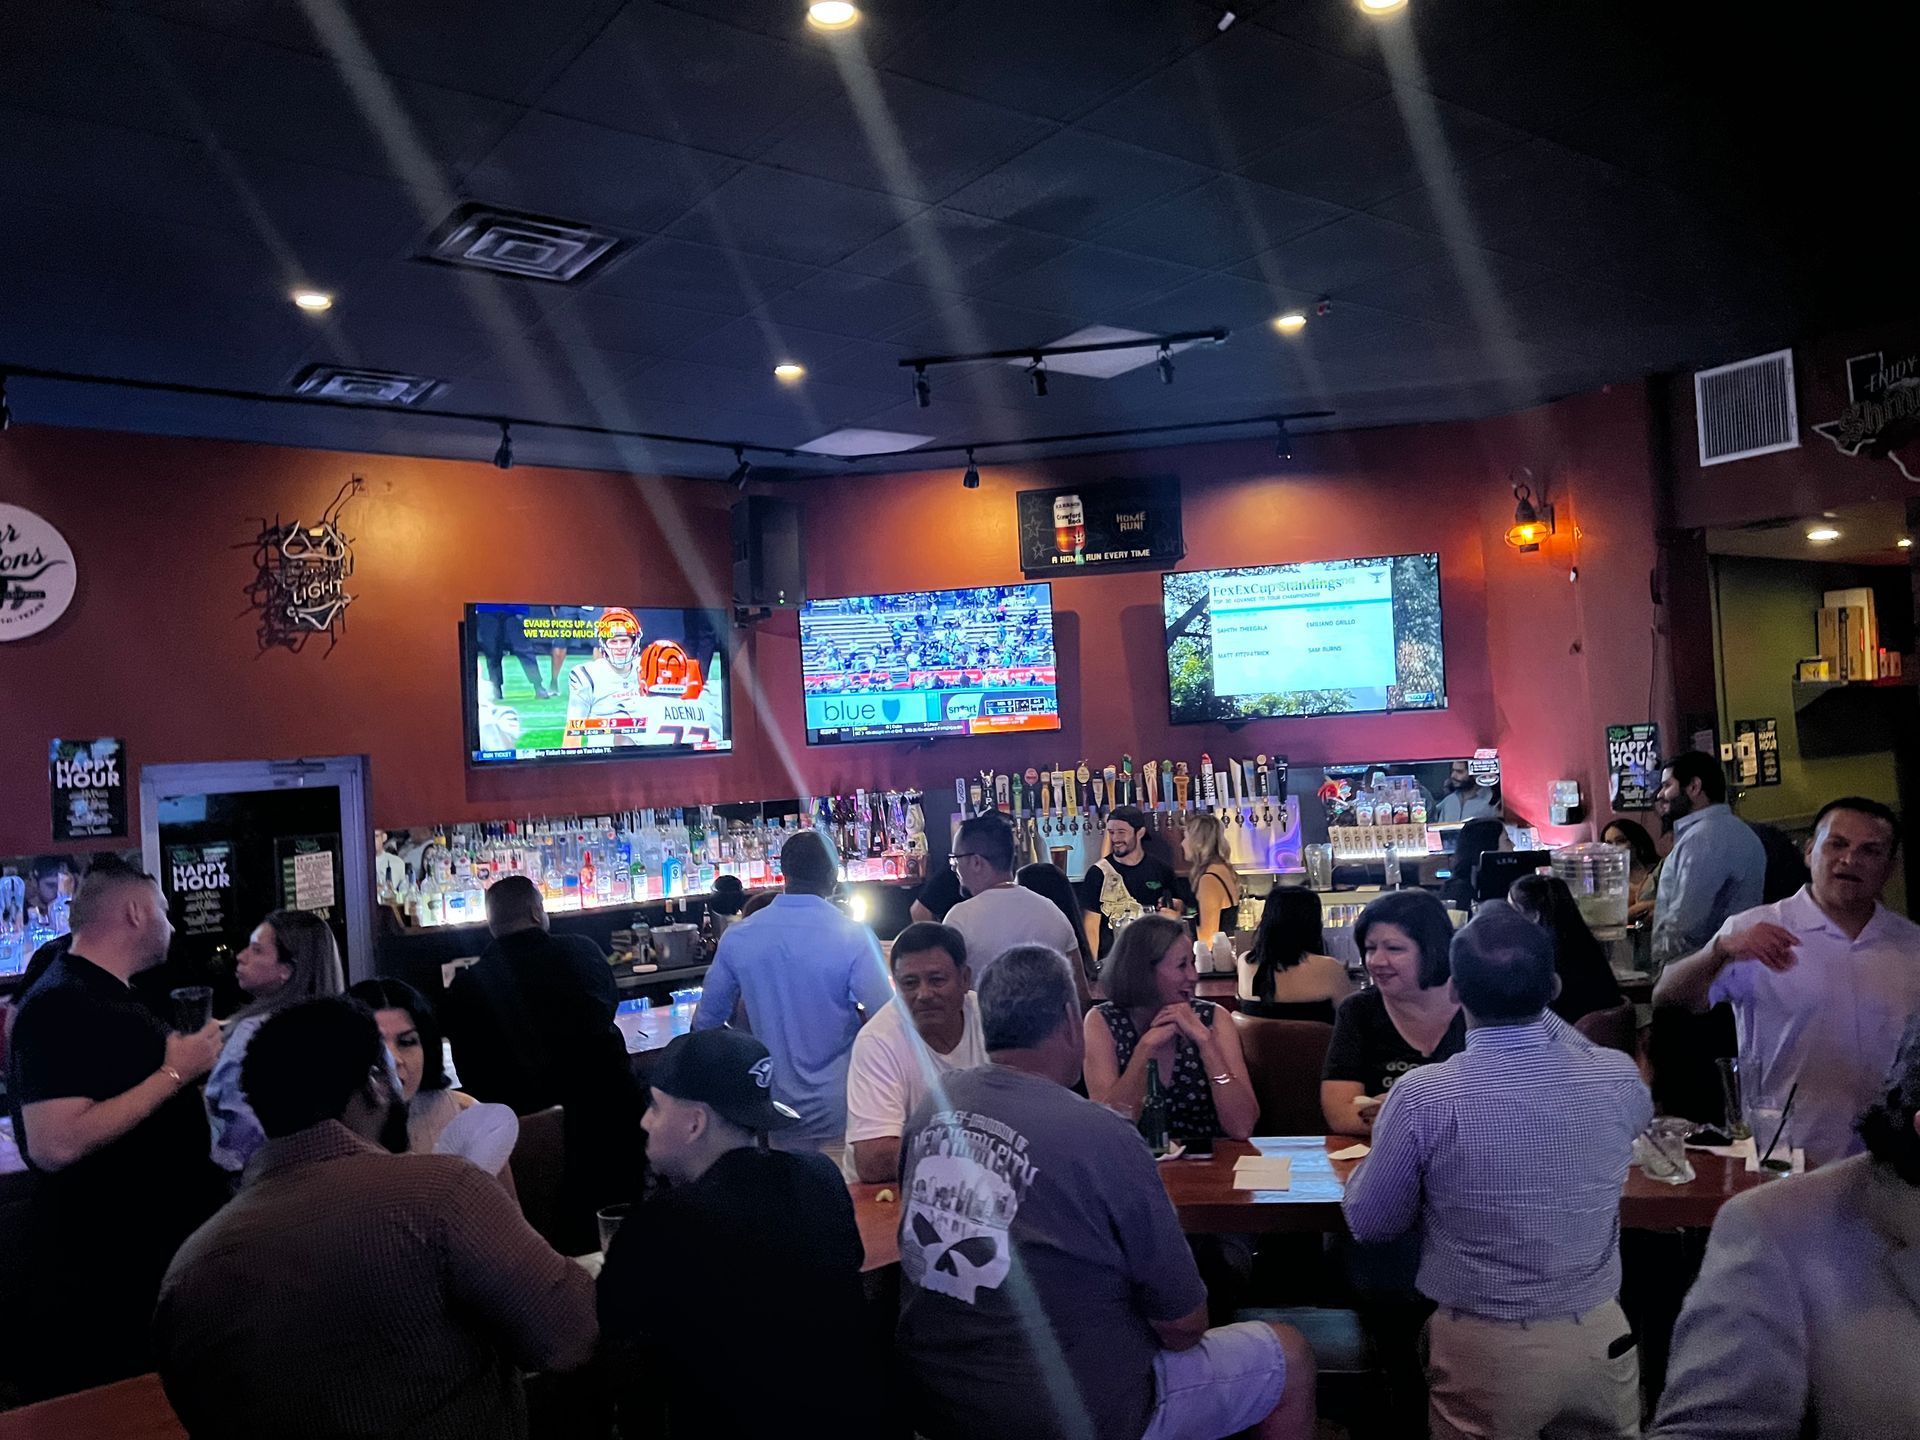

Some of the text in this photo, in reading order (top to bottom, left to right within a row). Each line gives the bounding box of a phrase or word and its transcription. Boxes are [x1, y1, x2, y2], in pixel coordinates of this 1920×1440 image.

[1116, 511, 1147, 524] HOME
[1120, 521, 1144, 533] RUN!
[1051, 549, 1151, 564] A HOME RUN EVERY TIME
[293, 577, 344, 605] LIGHT
[1277, 577, 1342, 592] Standings
[523, 619, 550, 628] EVANS
[551, 619, 574, 629] PICKS
[574, 619, 585, 629] UP
[586, 619, 593, 629] A
[1335, 618, 1356, 626] GRILLO
[524, 629, 538, 639] WE
[539, 629, 560, 639] TALK
[560, 629, 572, 639] SO
[573, 629, 597, 639] MUCH
[1322, 645, 1342, 653] BURNS
[664, 706, 705, 722] ADENIJI
[824, 700, 876, 721] blue
[948, 704, 977, 714] smart
[584, 747, 603, 755] YouTube
[1610, 740, 1654, 754] HAPPY
[56, 758, 117, 774] HAPPY
[56, 771, 121, 789] HOUR
[1206, 772, 1215, 799] TRULY
[173, 861, 227, 878] HAPPY
[173, 873, 231, 892] HOUR
